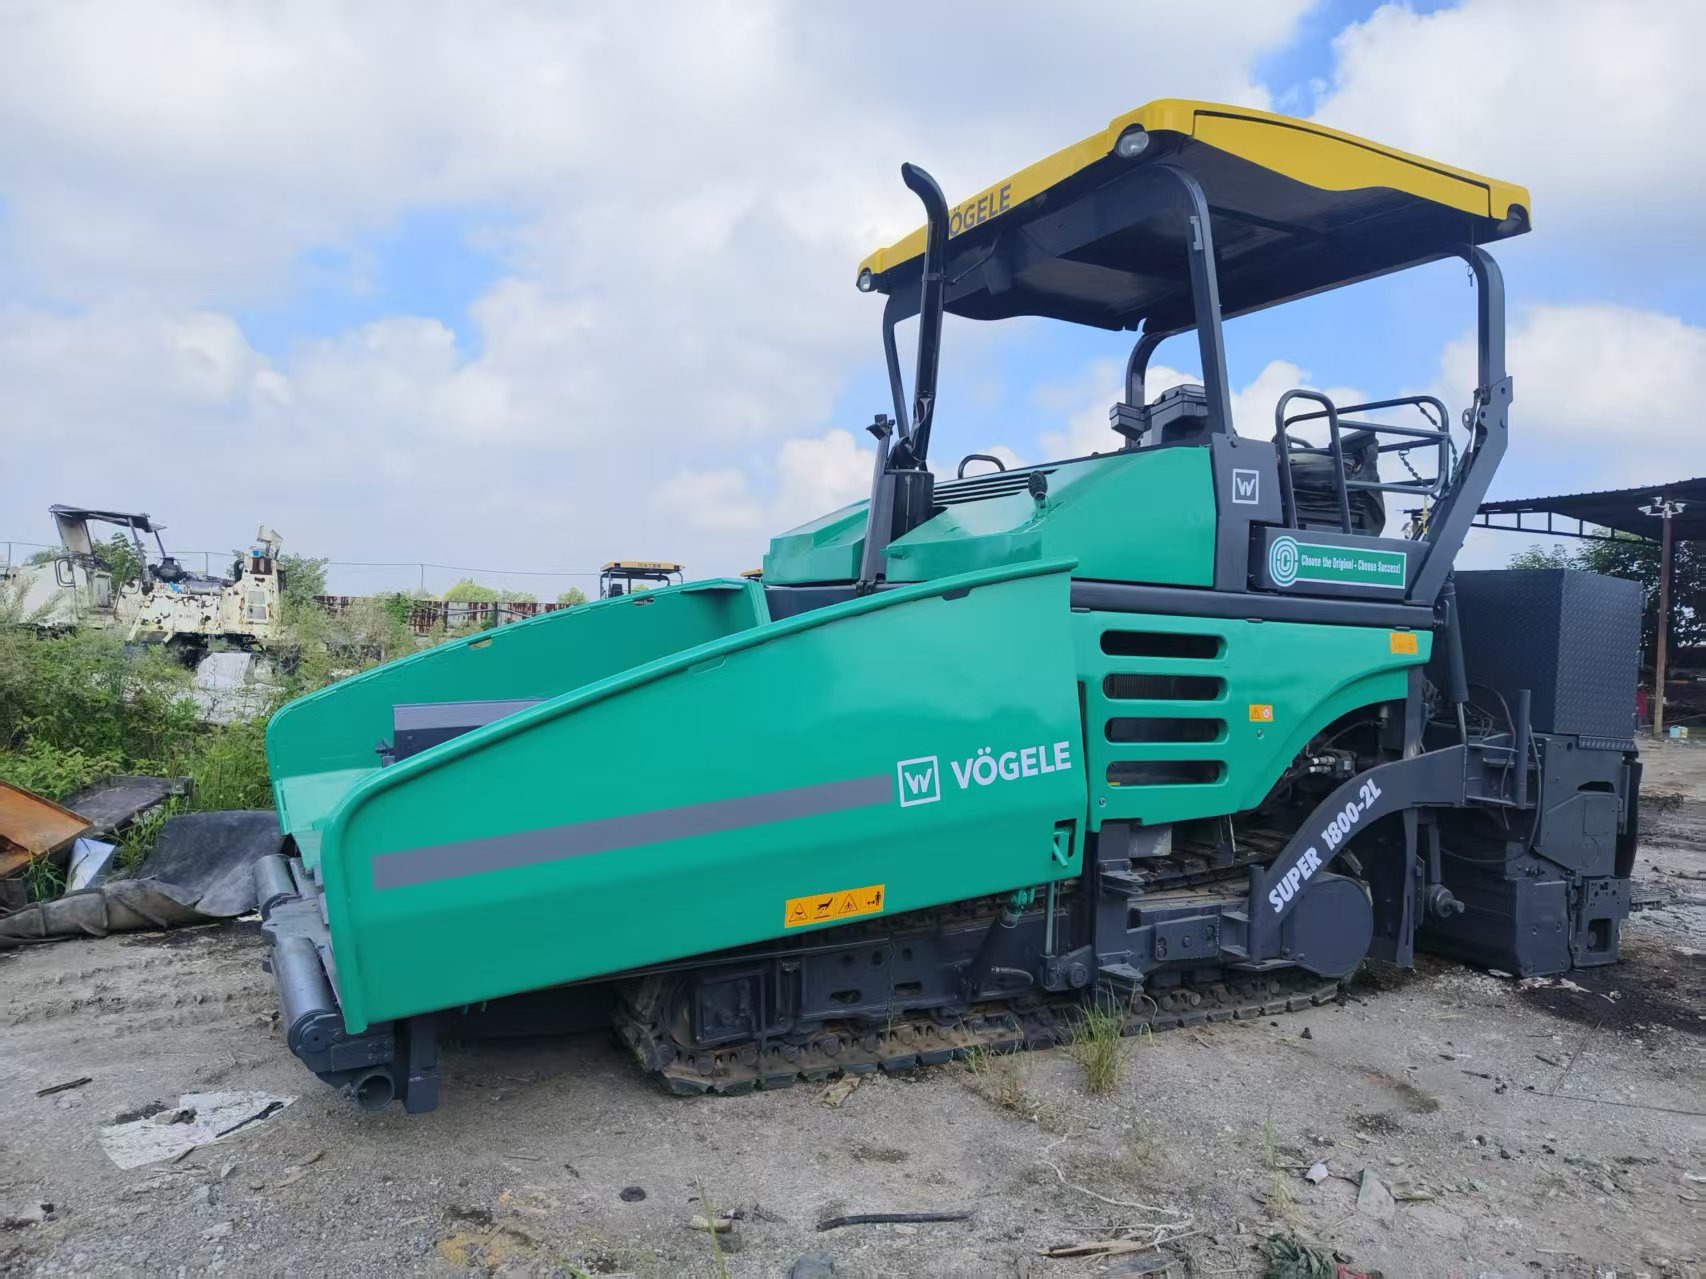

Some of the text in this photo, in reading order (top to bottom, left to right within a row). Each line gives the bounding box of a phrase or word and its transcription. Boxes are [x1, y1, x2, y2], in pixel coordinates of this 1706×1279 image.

[948, 184, 1012, 237] ÖGELE
[1301, 554, 1321, 567] Choose
[1322, 556, 1332, 568] the
[1333, 557, 1354, 571] Original
[1357, 559, 1377, 572] Choose
[1377, 561, 1401, 574] Success!
[903, 740, 1072, 795] W VÖGELE
[1268, 777, 1382, 913] SUPER 1800-2L
